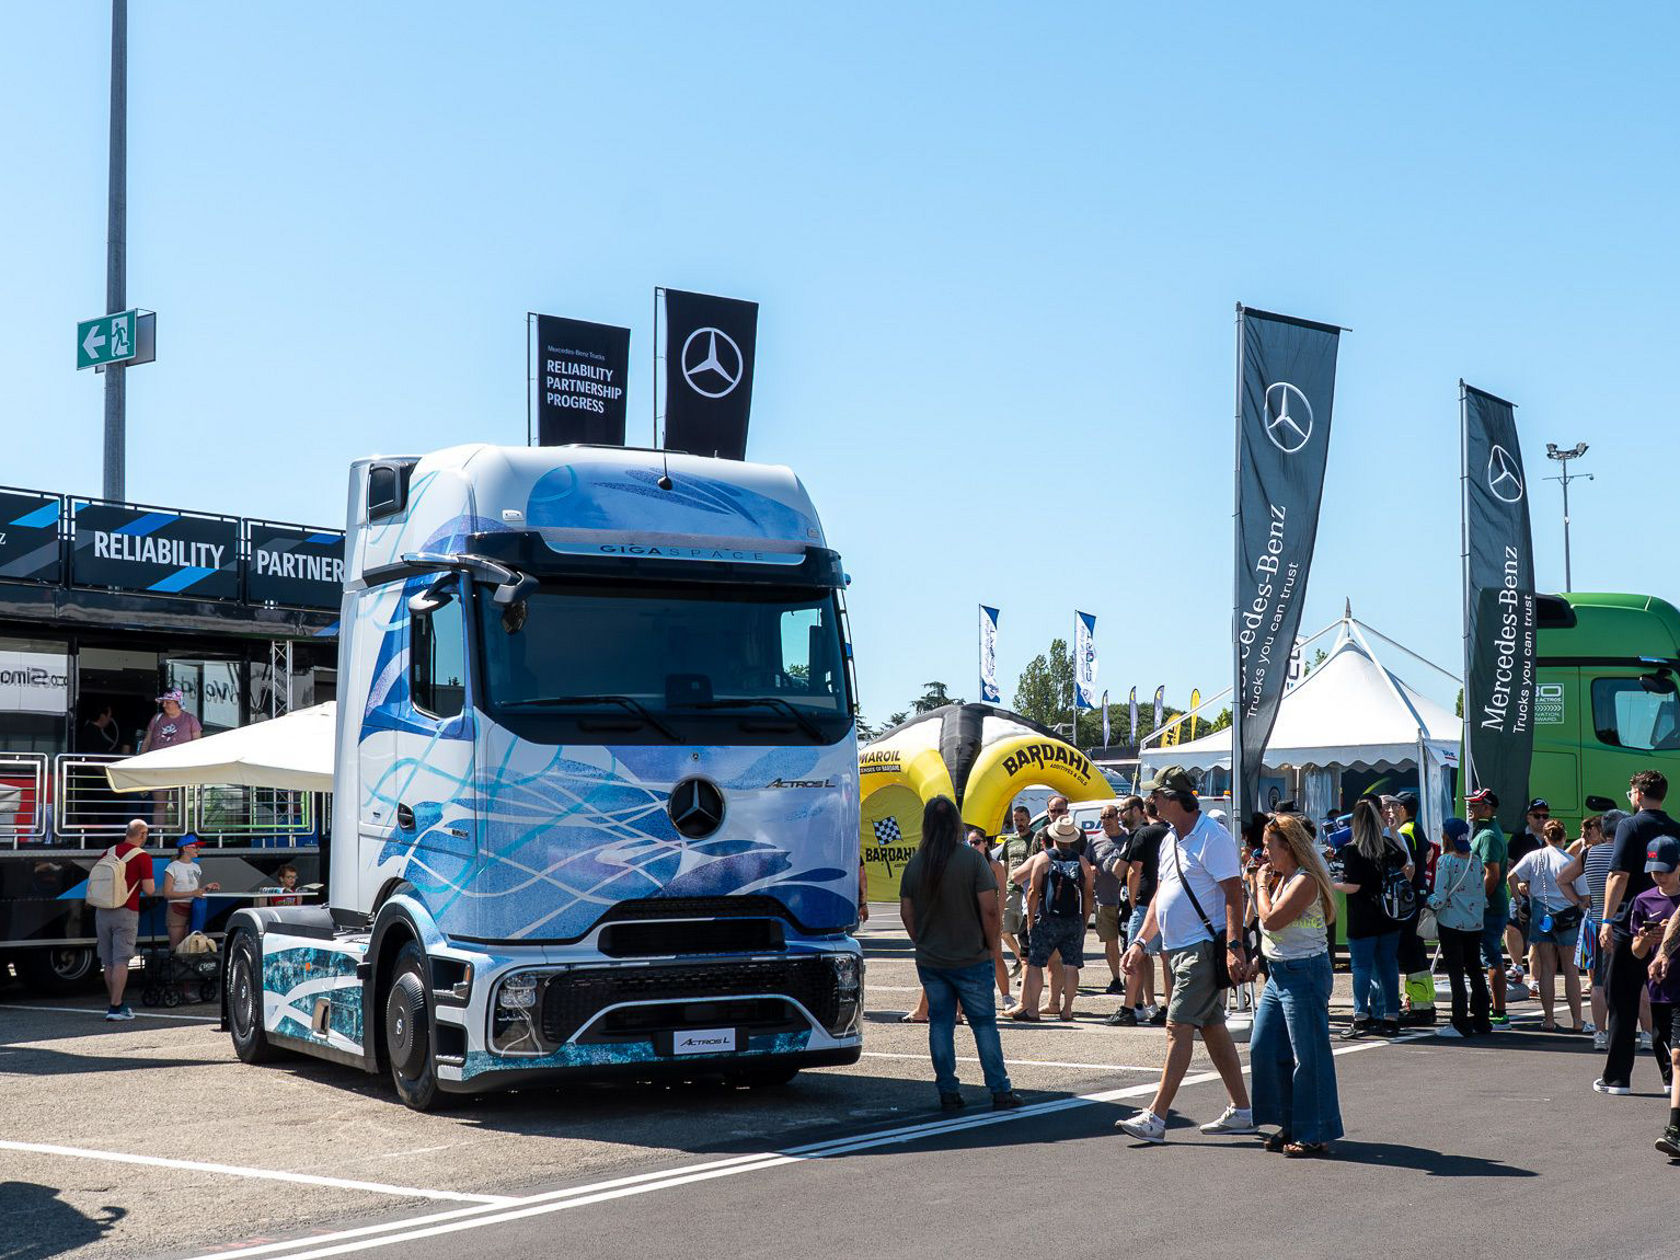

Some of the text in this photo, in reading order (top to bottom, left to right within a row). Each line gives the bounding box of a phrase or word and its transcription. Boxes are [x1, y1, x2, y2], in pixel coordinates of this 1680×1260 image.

[547, 359, 613, 382] RELIABILITY
[547, 376, 622, 399] PARTNERSHIP
[547, 392, 605, 414] PROGRESS
[94, 530, 224, 570] RELIABILITY
[1240, 503, 1286, 706] cedes-Benz
[1247, 562, 1299, 718] Trucks you can trust
[1481, 546, 1518, 733] Mercedes-Benz
[1513, 595, 1532, 734] Trucks you can trust
[1002, 744, 1091, 777] BARDAHL
[766, 778, 836, 788] ACTROS L
[680, 1038, 722, 1047] ACTROS
